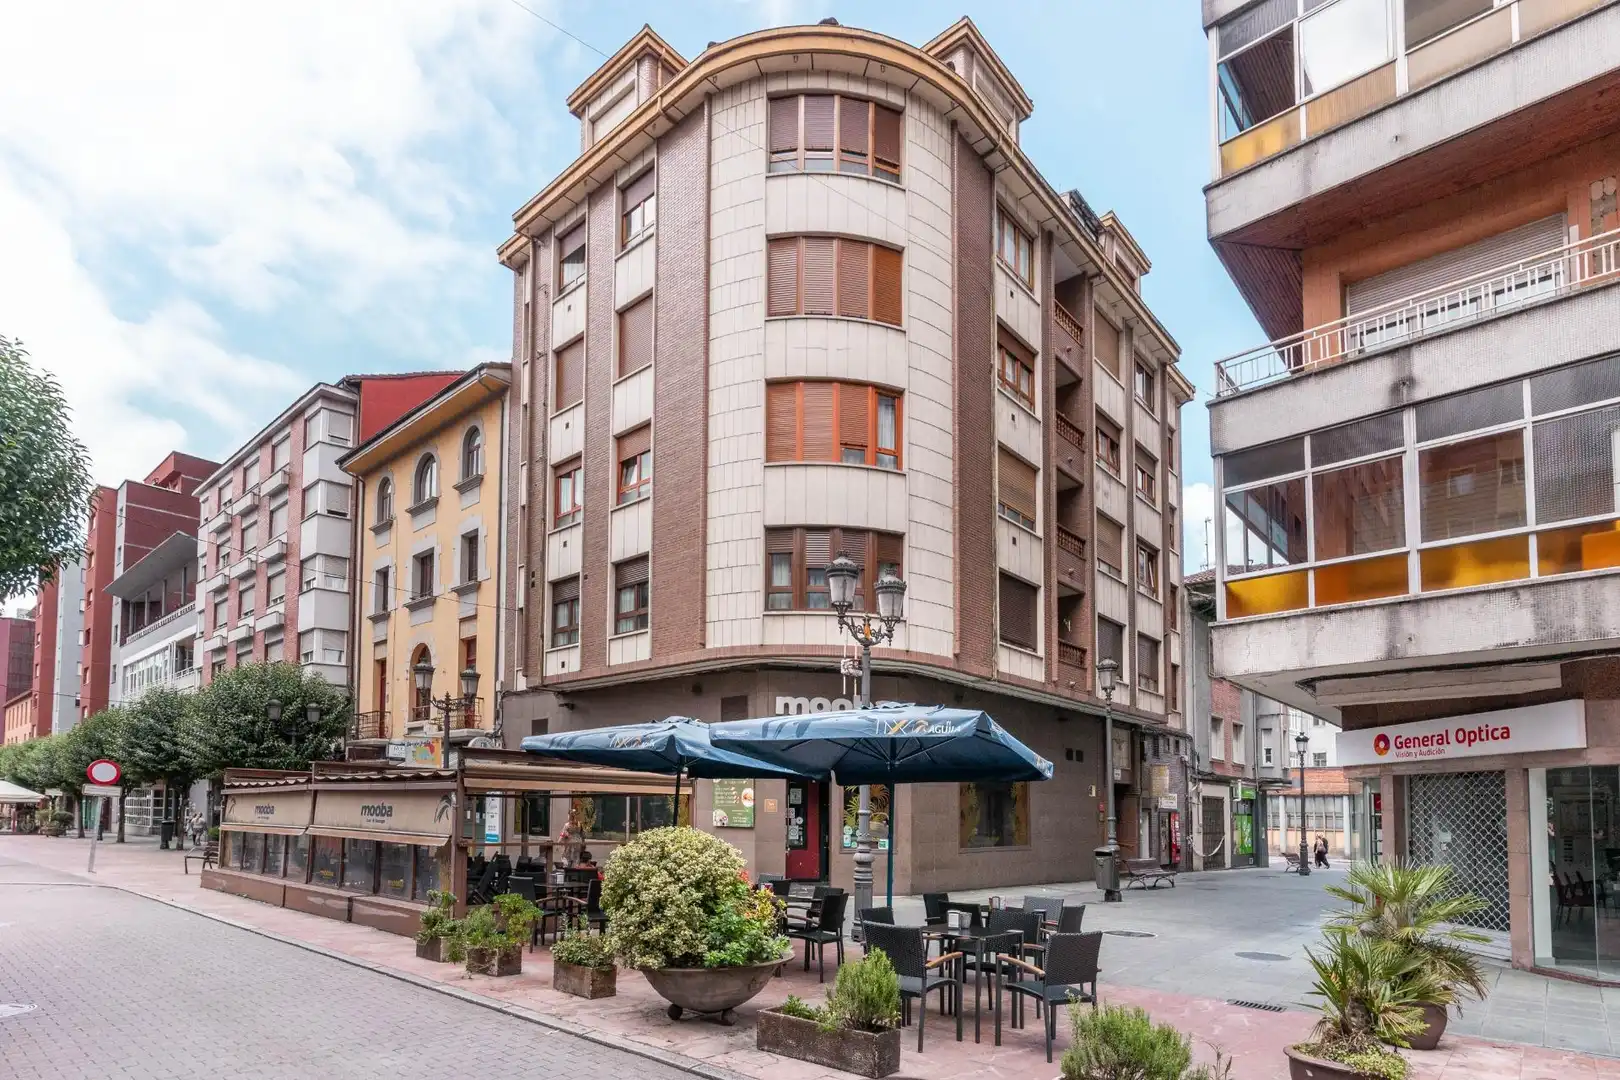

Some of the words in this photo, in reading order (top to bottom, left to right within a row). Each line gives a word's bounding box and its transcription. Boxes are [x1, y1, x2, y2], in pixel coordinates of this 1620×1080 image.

[1395, 729, 1450, 749] General
[1455, 724, 1510, 747] Optica
[1395, 750, 1412, 758] Visión
[1418, 748, 1446, 757] Audición
[361, 802, 393, 818] mooba
